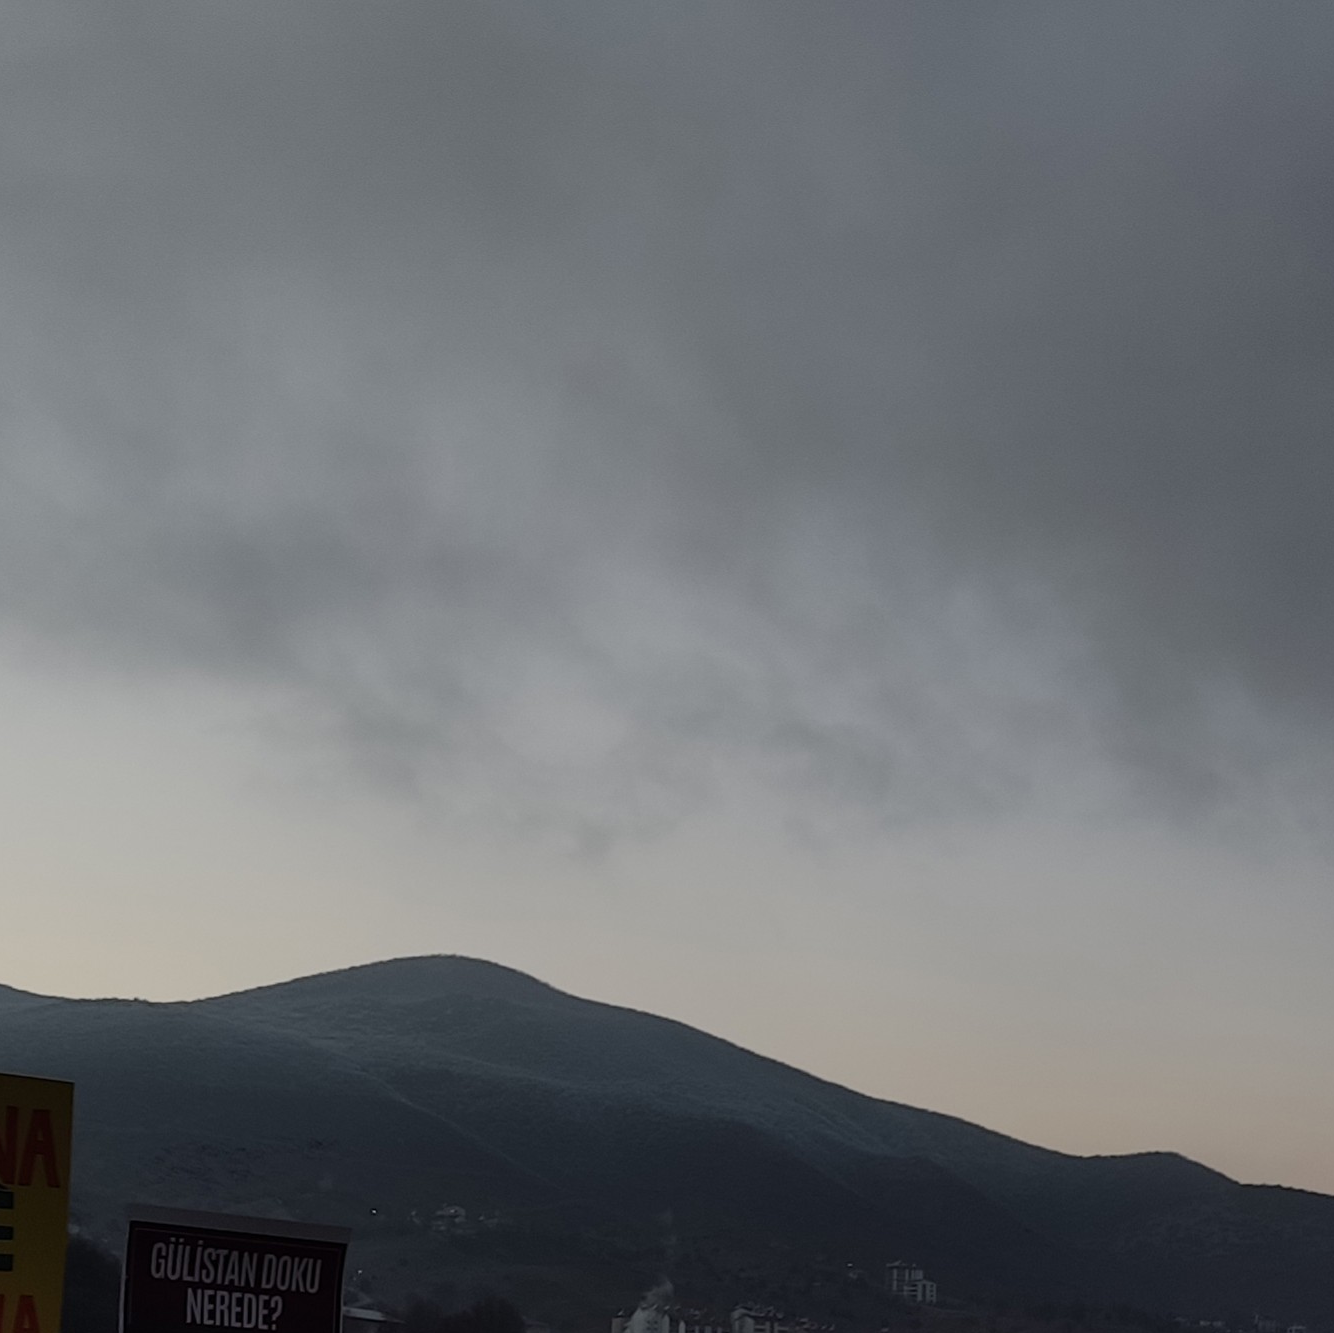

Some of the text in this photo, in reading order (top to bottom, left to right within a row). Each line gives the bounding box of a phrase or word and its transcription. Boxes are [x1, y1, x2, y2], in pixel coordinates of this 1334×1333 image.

[150, 1236, 323, 1294] GÜLİSTAN DOKU
[185, 1286, 284, 1331] NEREDE?
